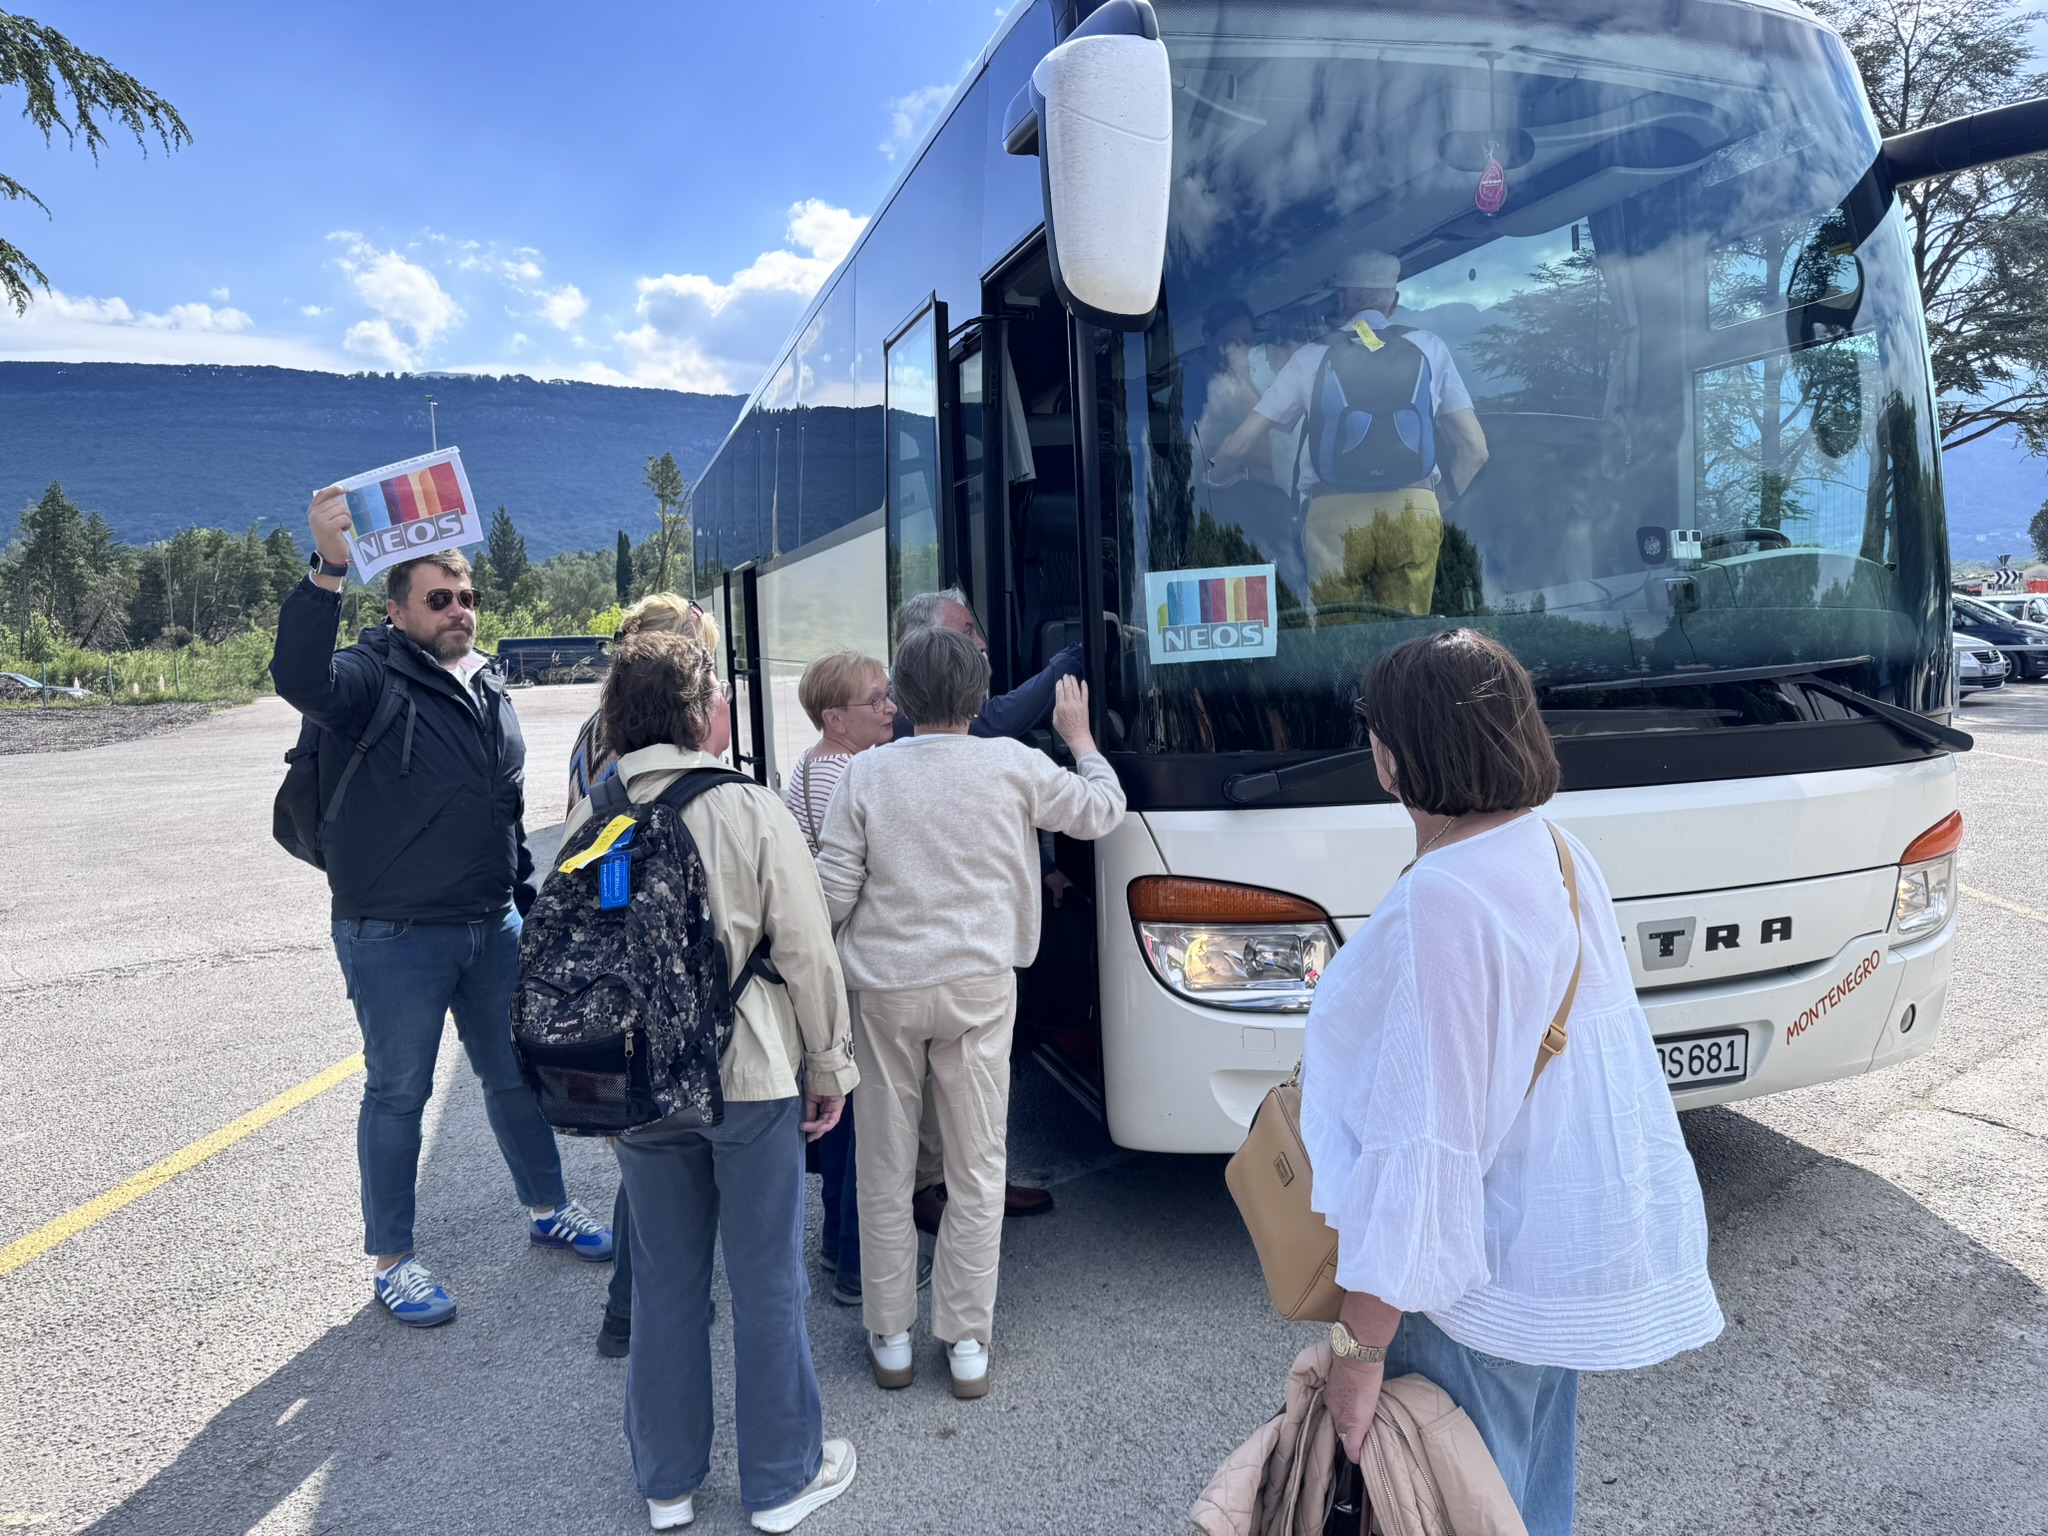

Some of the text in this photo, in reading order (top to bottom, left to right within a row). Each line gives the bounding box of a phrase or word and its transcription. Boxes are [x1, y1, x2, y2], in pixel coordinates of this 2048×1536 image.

[358, 514, 462, 563] NEOS
[1165, 624, 1263, 652] NEOS
[1622, 916, 1792, 958] TRA
[1786, 949, 1881, 1045] MONTENEGRO
